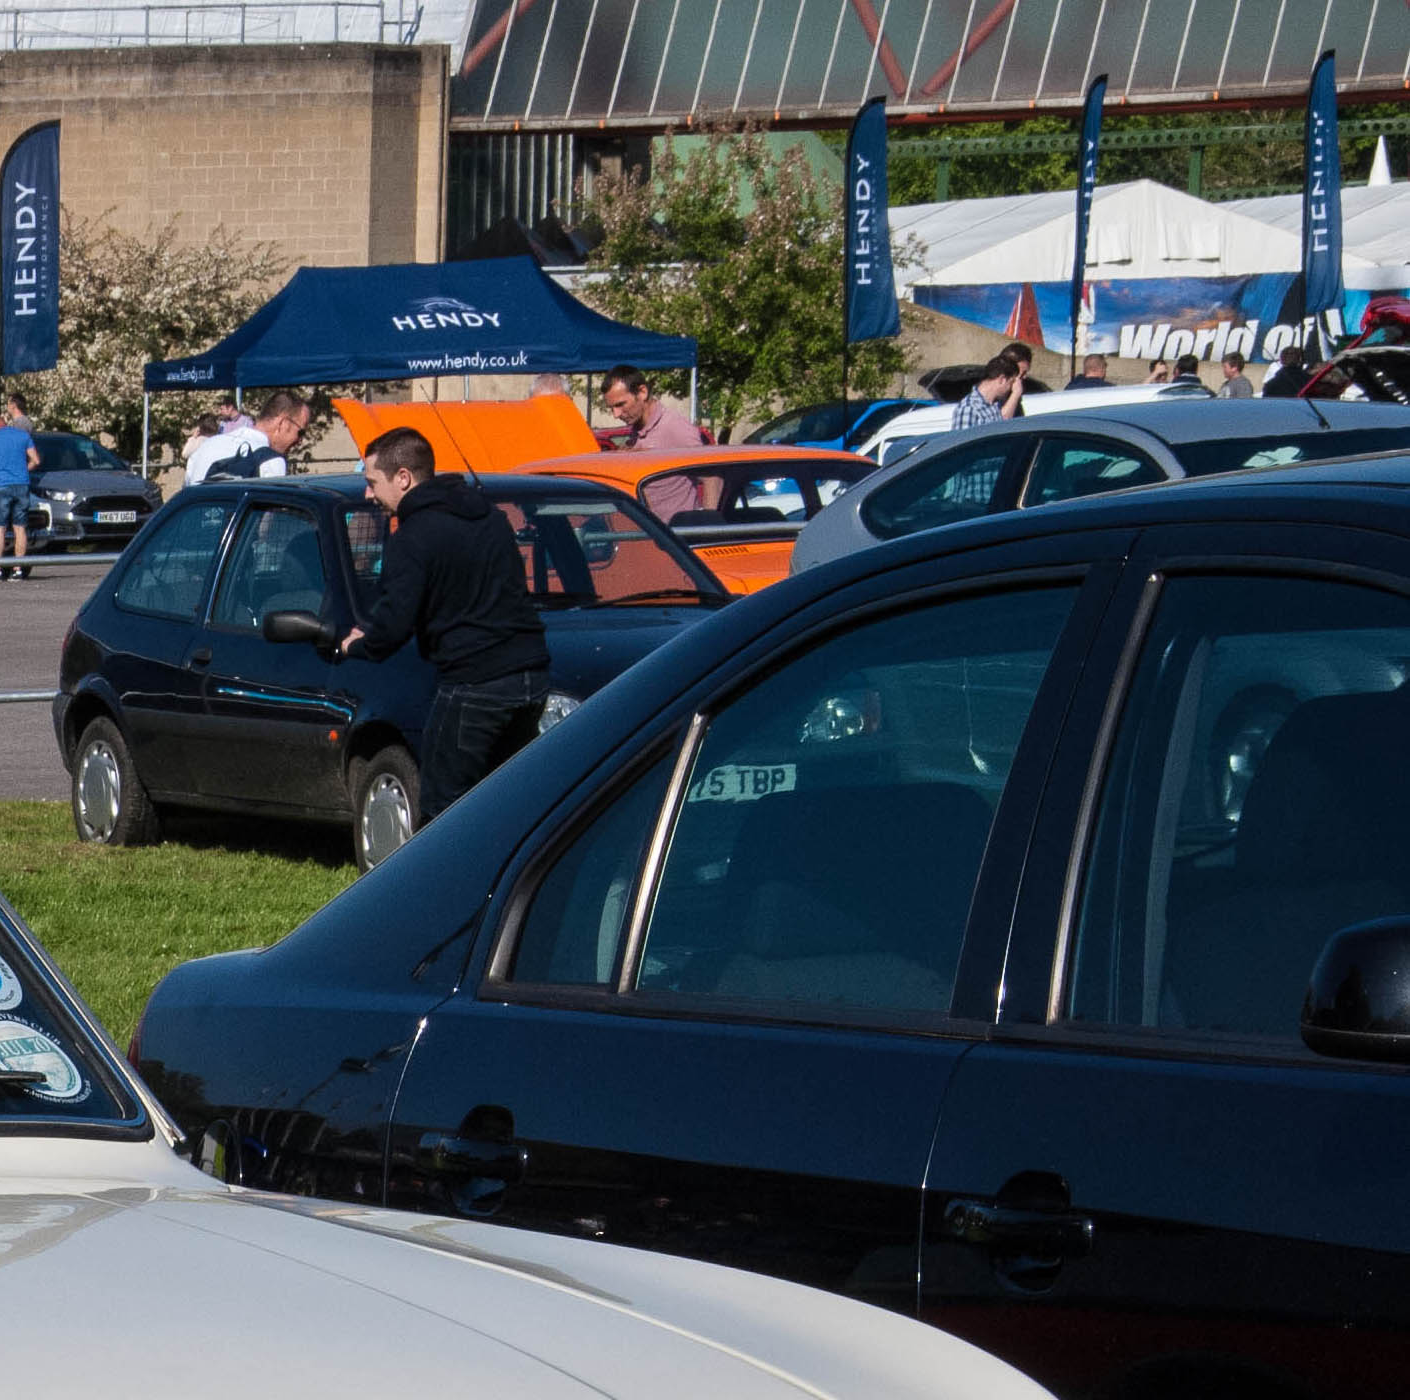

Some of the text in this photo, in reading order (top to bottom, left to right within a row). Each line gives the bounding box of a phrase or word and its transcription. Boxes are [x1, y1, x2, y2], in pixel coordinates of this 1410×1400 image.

[855, 153, 872, 286] HENDY
[14, 181, 37, 316] HENDY
[391, 302, 501, 331] HENDY
[1119, 319, 1259, 362] World
[407, 350, 529, 371] www.hendy.co.uk
[737, 767, 785, 795] TBP
